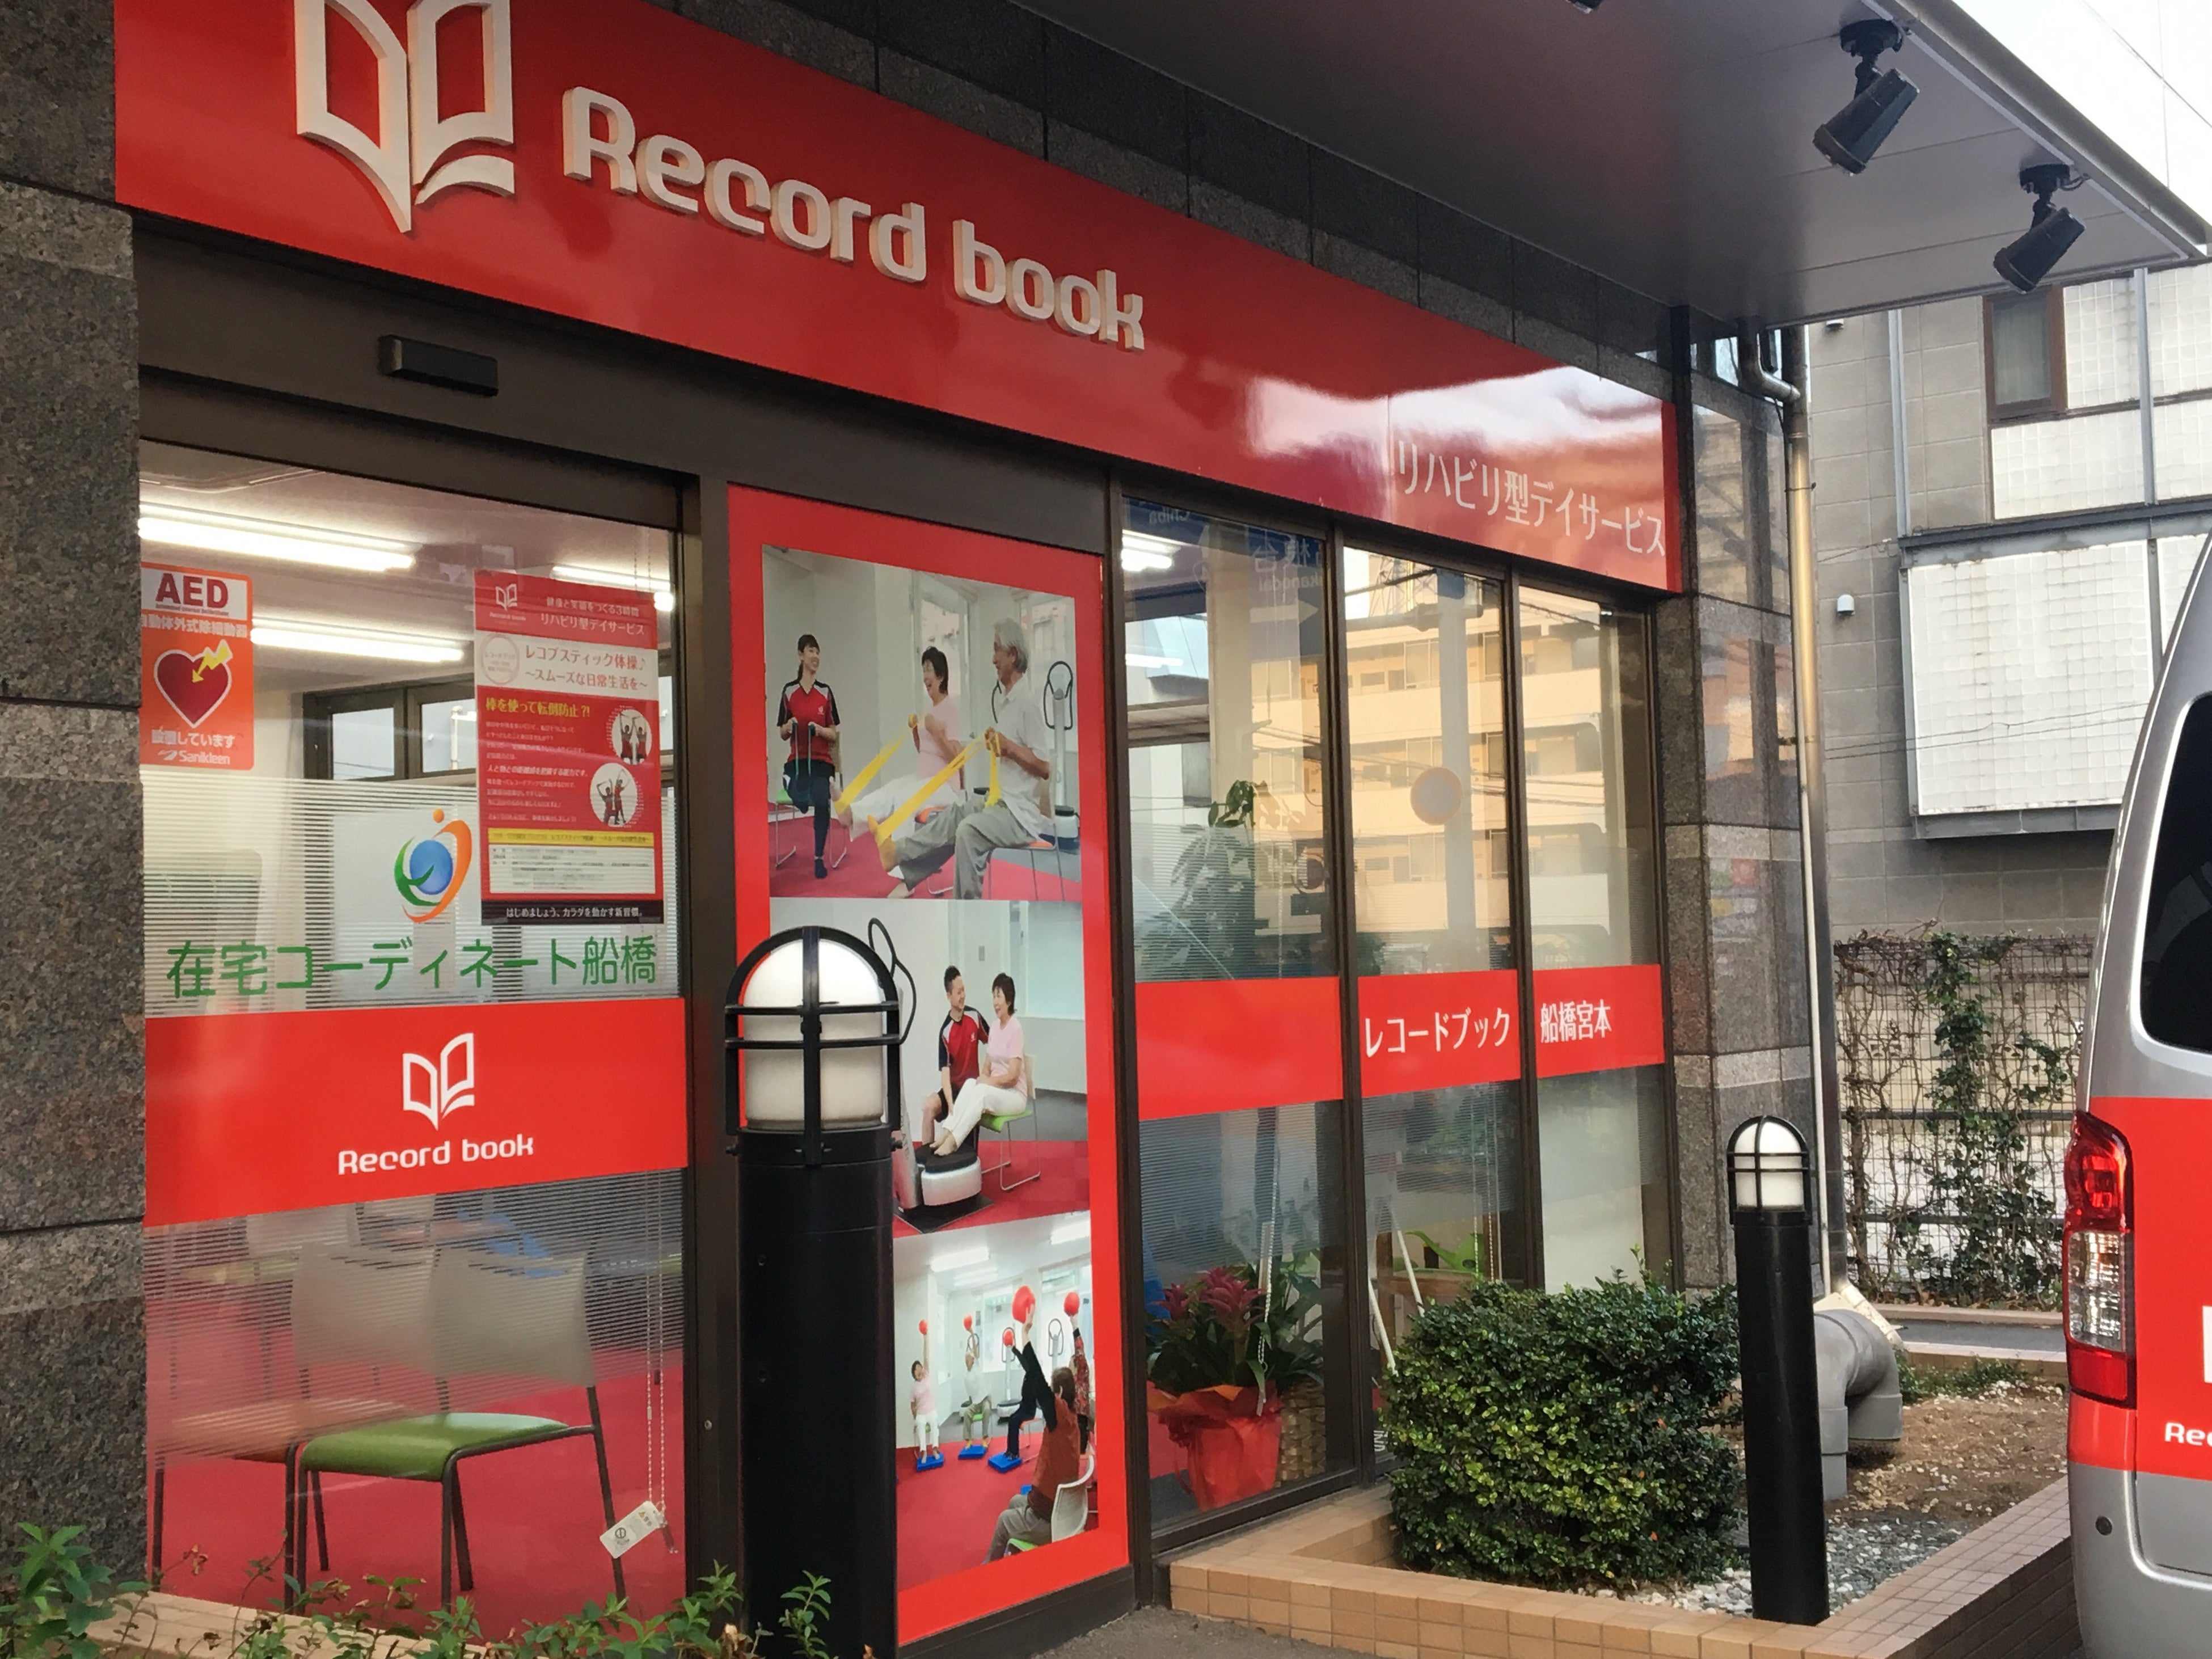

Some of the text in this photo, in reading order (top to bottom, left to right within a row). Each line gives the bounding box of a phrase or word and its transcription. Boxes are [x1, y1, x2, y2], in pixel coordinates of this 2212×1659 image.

[562, 86, 1145, 351] Record book
[1399, 440, 1666, 557] リハビリ型デイサービス
[155, 572, 229, 609] AED
[167, 935, 657, 998] 在宅コーディネート船橋
[1365, 999, 1612, 1058] レコードブック 船橋宮本
[338, 1133, 534, 1175] Record book
